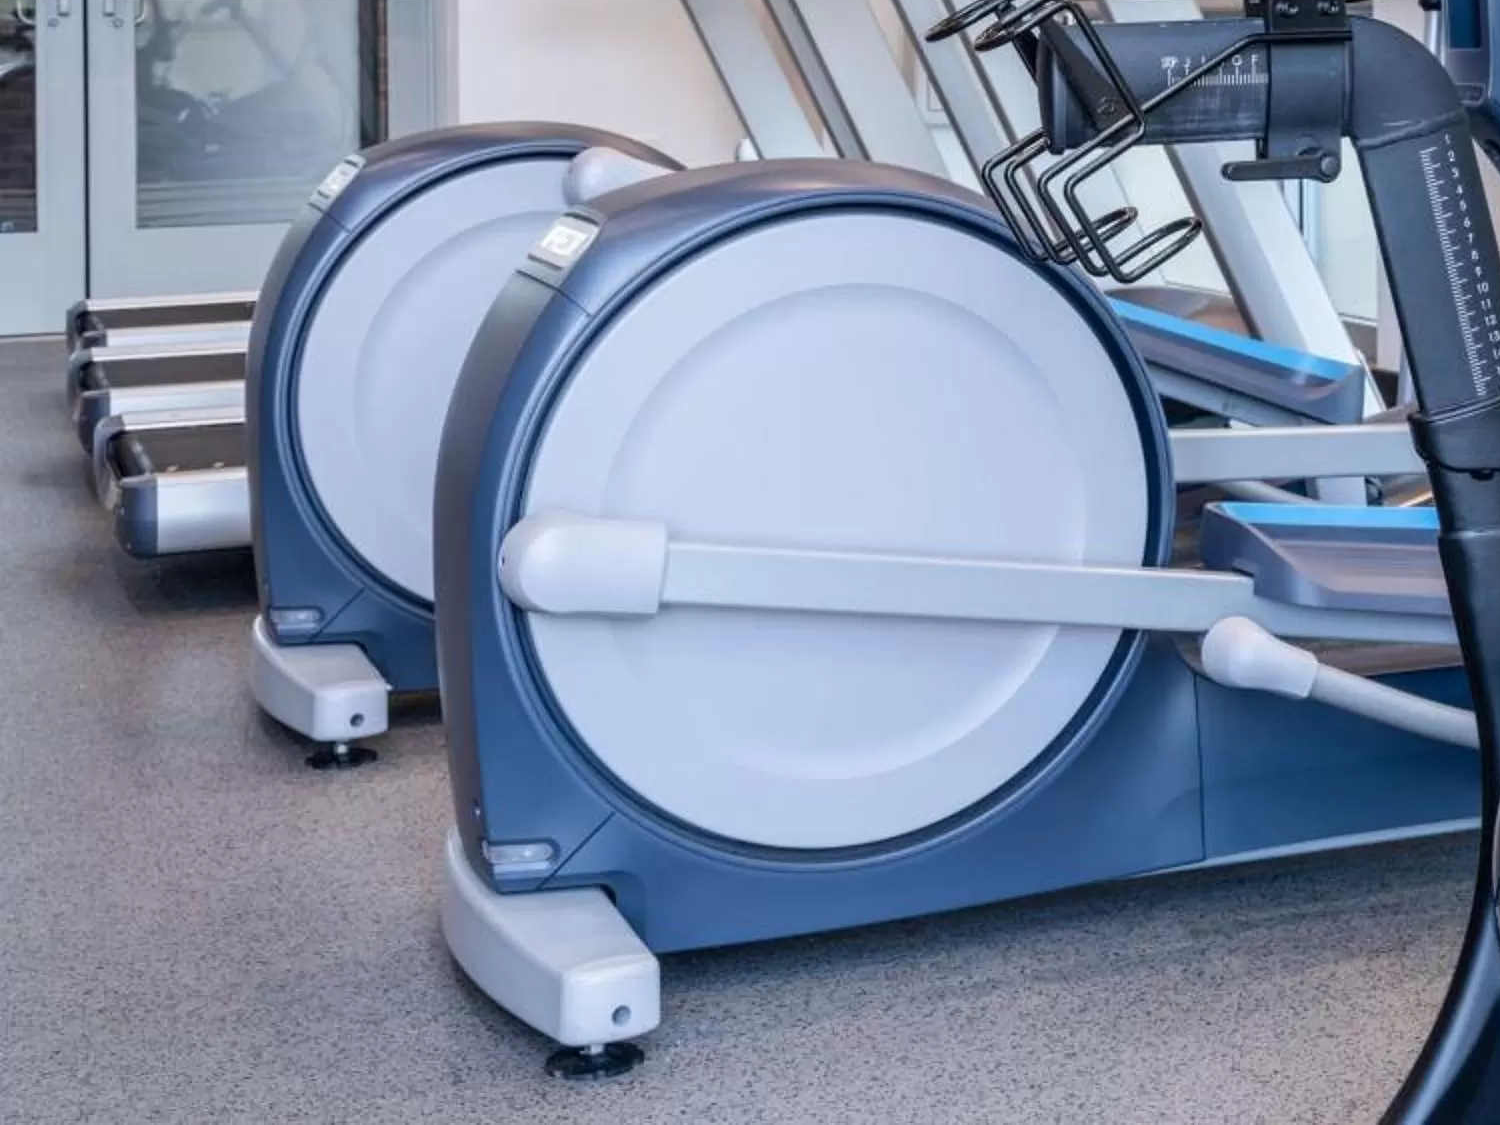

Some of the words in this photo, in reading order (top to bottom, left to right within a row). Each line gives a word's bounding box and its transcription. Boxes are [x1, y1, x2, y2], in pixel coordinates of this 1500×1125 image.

[1476, 282, 1489, 294] 10
[1480, 298, 1492, 311] 11
[1484, 314, 1497, 326] 12
[1488, 330, 1500, 343] 13
